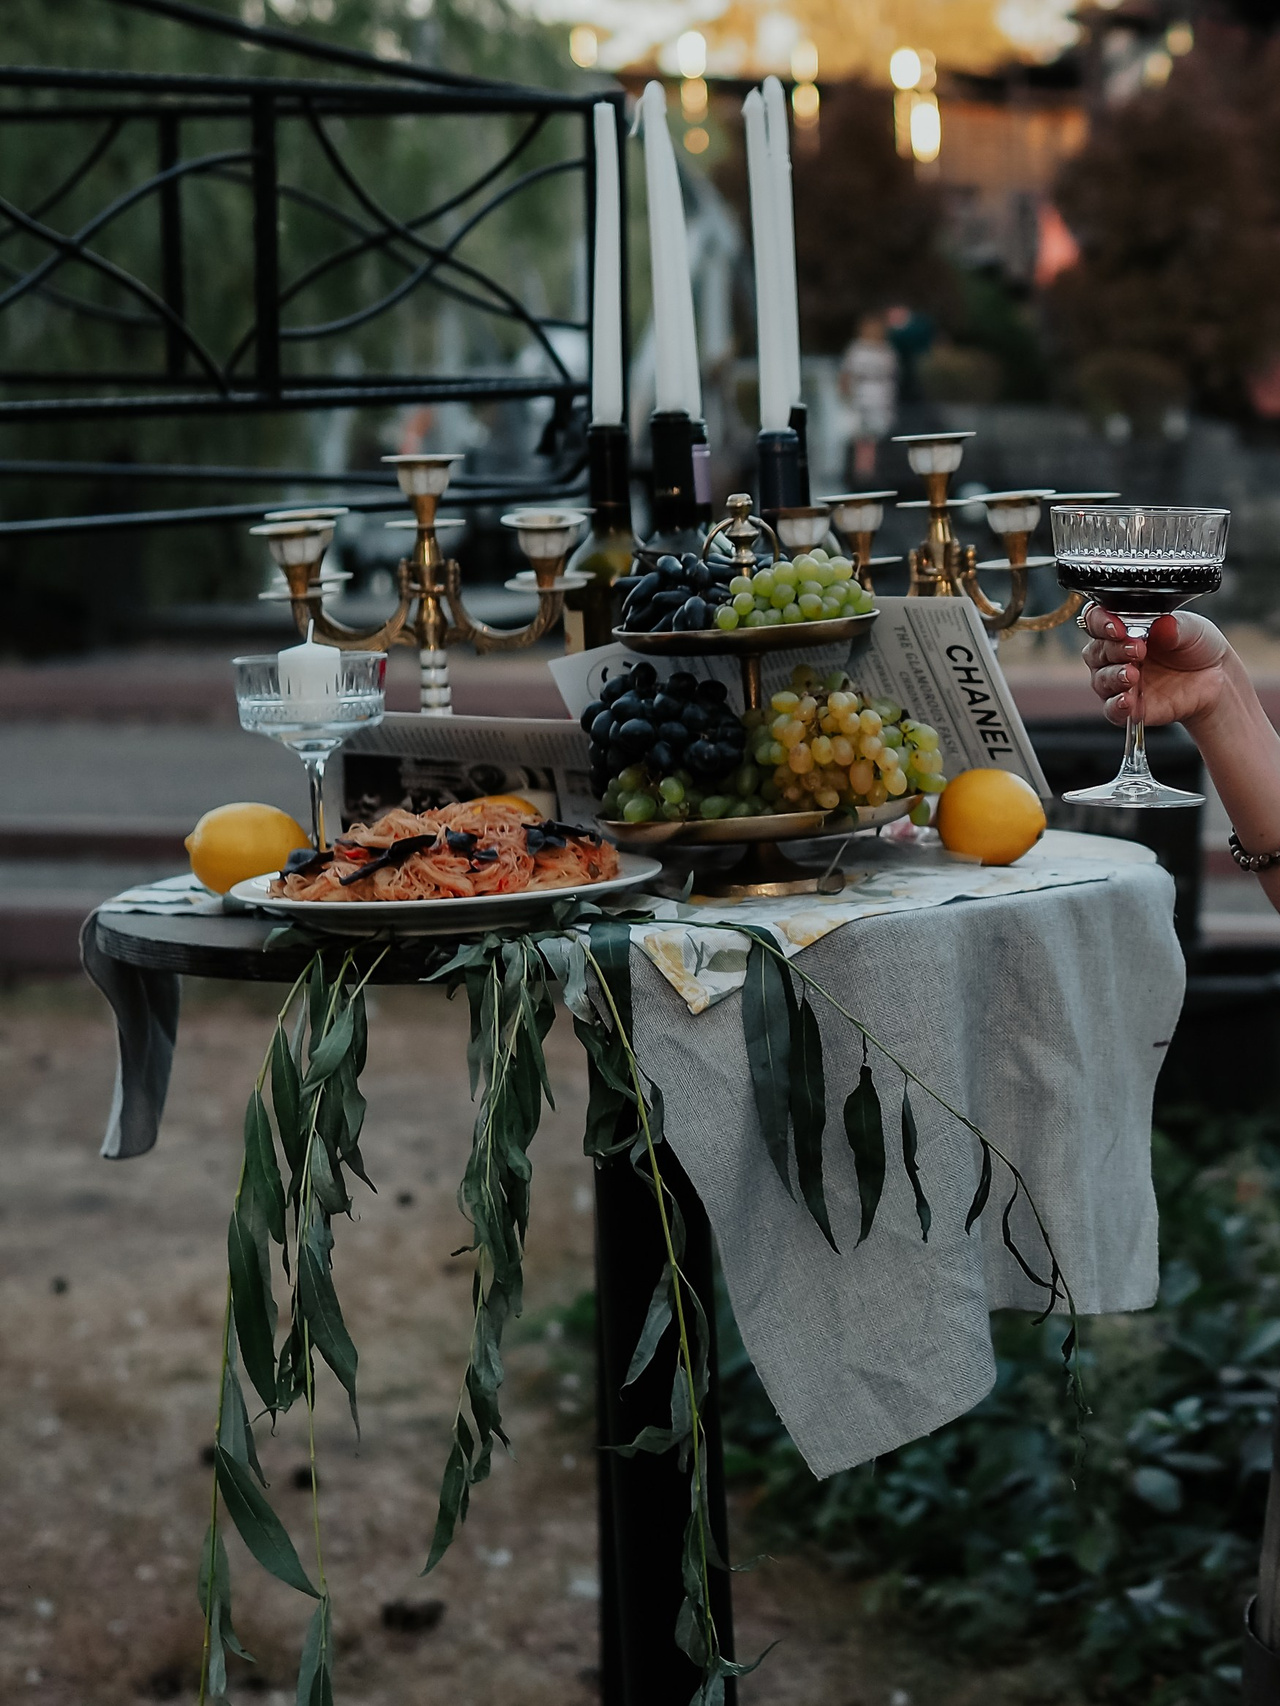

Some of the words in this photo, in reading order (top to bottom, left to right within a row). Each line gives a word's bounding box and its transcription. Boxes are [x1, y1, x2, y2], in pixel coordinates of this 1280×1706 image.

[894, 625, 913, 649] THE
[905, 653, 945, 724] GLAMOROUS
[937, 724, 959, 754] FASH
[900, 671, 929, 722] CHRONICLE
[946, 645, 1013, 761] CHANEL
